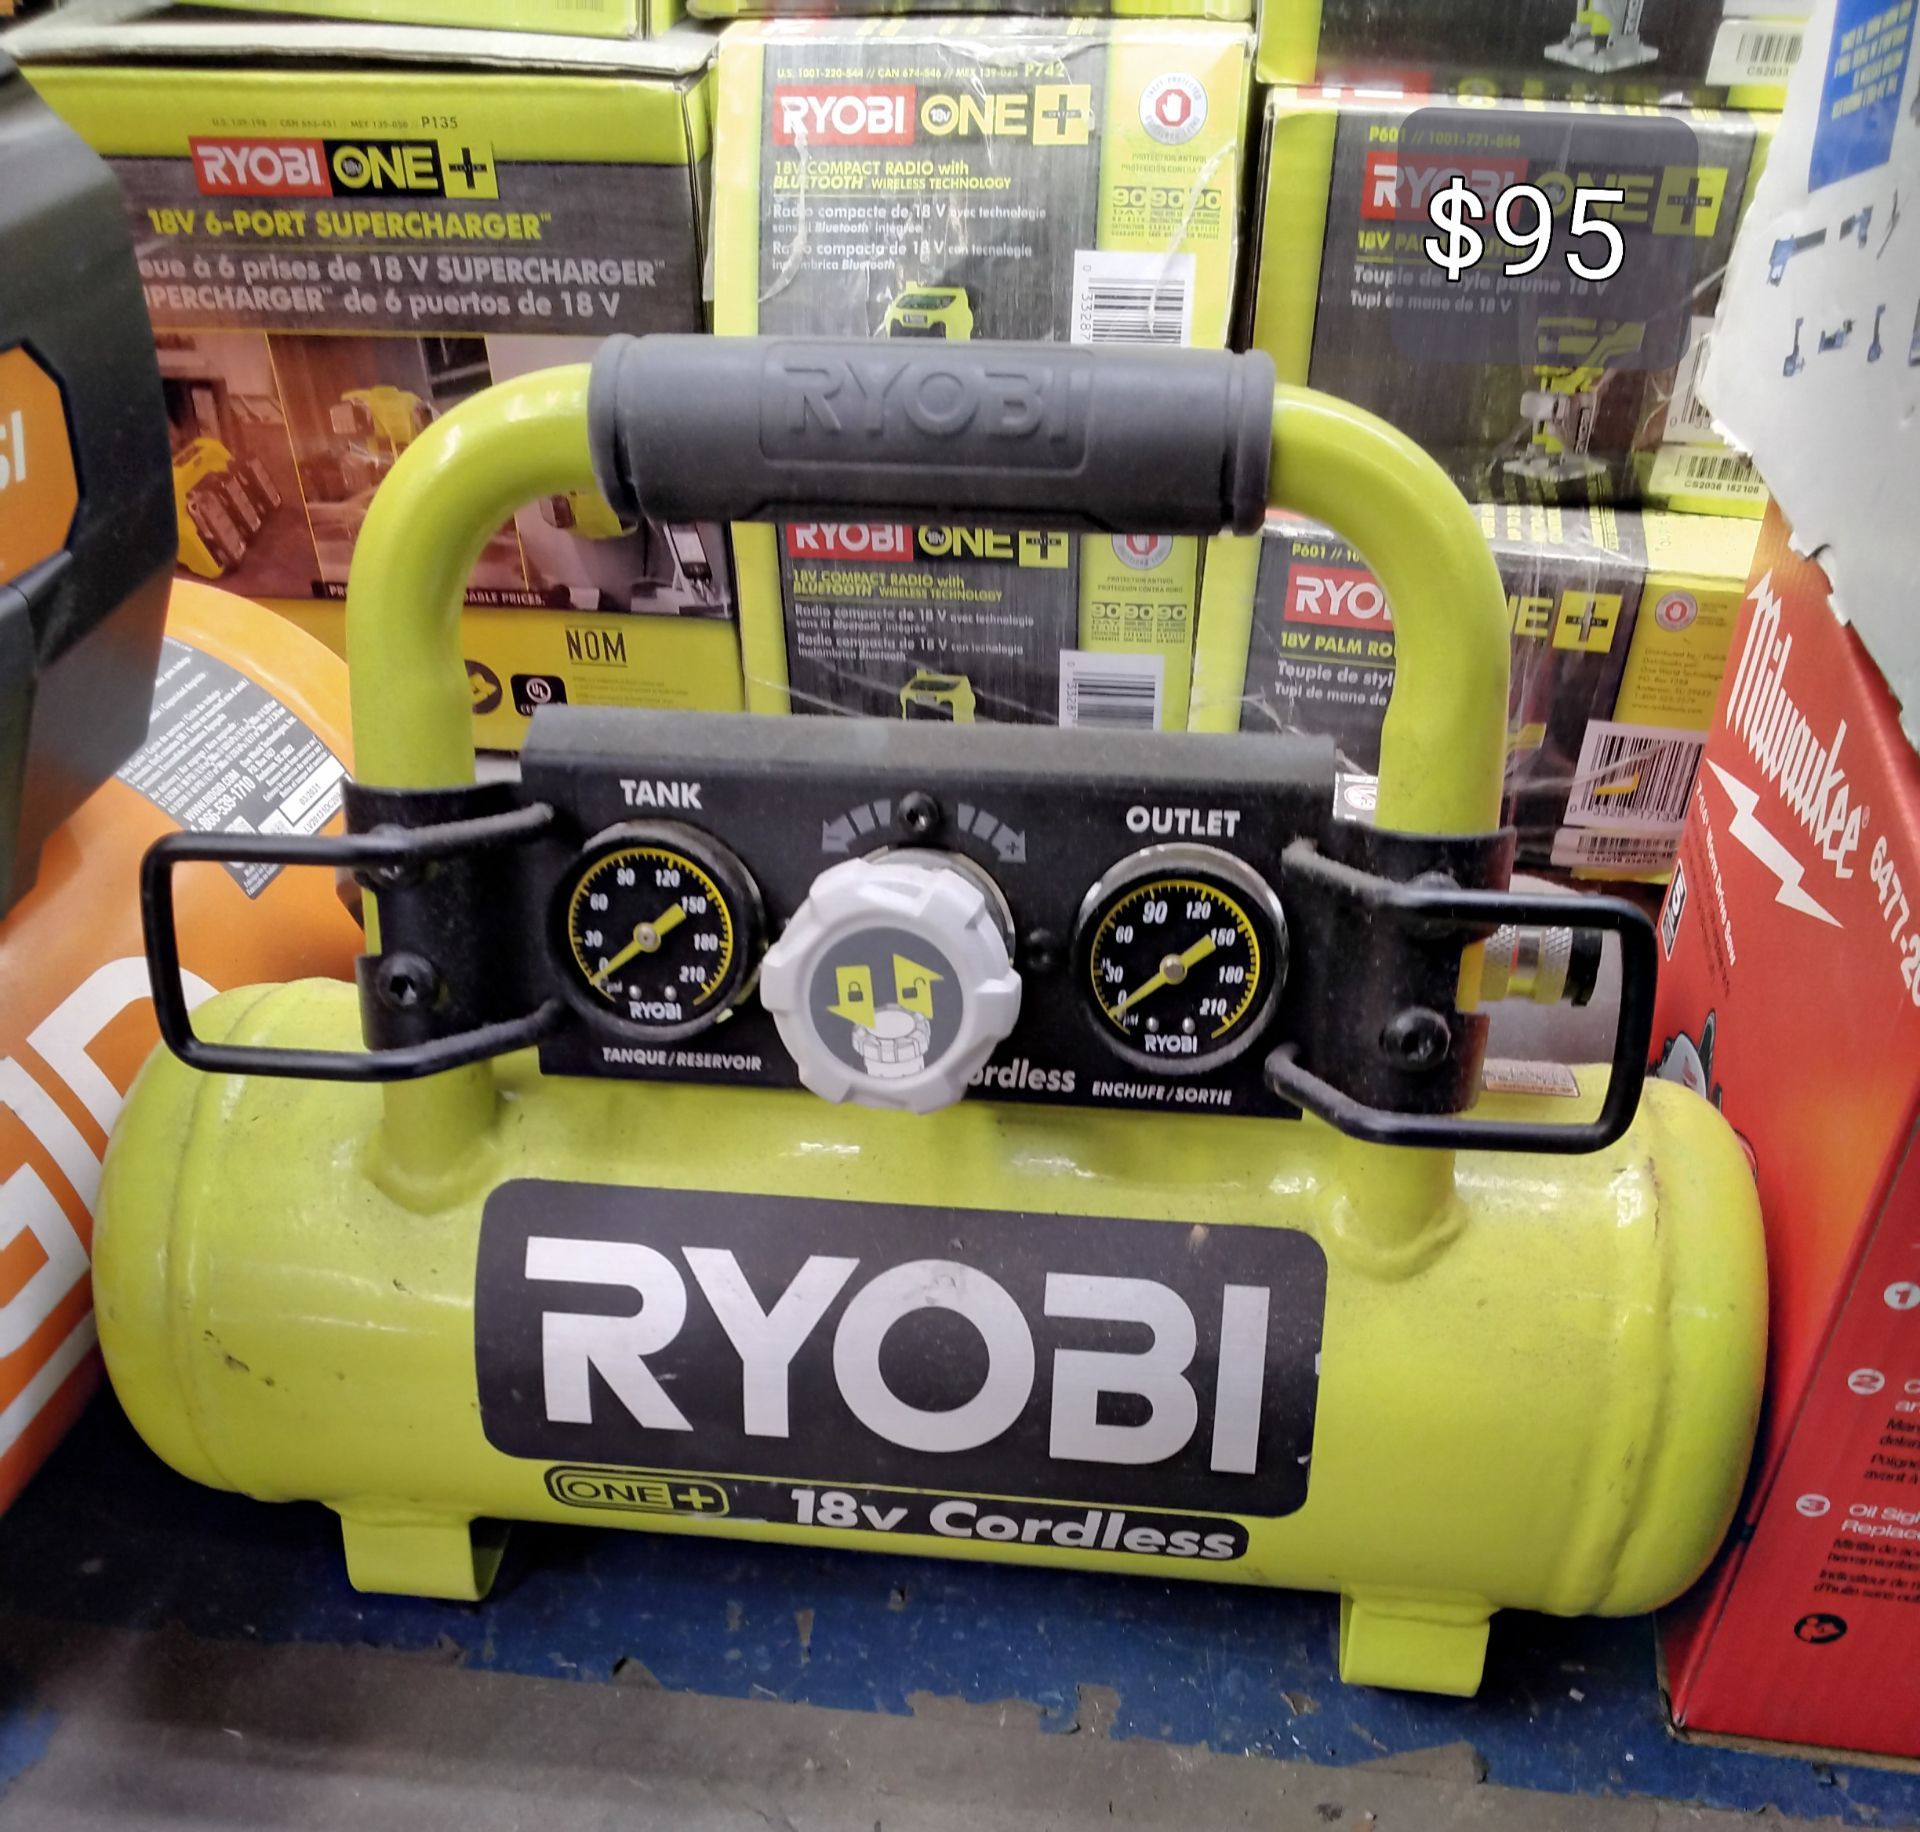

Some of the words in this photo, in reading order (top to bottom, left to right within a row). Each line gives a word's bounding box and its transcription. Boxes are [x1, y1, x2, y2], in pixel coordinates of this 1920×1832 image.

[421, 115, 458, 130] P135
[781, 95, 906, 135] RYOBI
[1369, 125, 1405, 143] P601
[196, 145, 323, 187] RYOBI
[807, 160, 881, 176] COMPACT
[885, 160, 934, 176] RADIO
[938, 160, 969, 177] with
[773, 175, 864, 190] BLUTOOTH
[871, 177, 926, 191] WIRELESS
[929, 176, 1012, 190] TECHNOLOGY
[147, 208, 195, 236] 18V
[204, 209, 306, 237] 6-PORT
[773, 204, 814, 219] Rado
[818, 205, 886, 221] compacte
[891, 203, 909, 218] de
[912, 204, 931, 218] 18
[979, 205, 1046, 221] technologie
[1358, 231, 1391, 251] 18V
[218, 253, 236, 279] 6
[242, 254, 321, 285] prises
[327, 254, 362, 281] de
[369, 255, 403, 282] 18
[407, 256, 429, 283] V
[343, 286, 378, 314] de
[384, 287, 402, 313] 6
[409, 291, 511, 320] puertos
[517, 290, 551, 316] de
[560, 291, 595, 317] 18
[599, 292, 620, 318] V
[782, 361, 1075, 444] RYOBI
[795, 524, 905, 553] RYOBI
[1292, 543, 1326, 560] P601
[821, 571, 886, 587] COMPACT
[890, 572, 934, 588] RADIO
[937, 574, 965, 589] with
[1295, 575, 1392, 621] RYO
[565, 629, 627, 664] NOM
[1281, 631, 1311, 648] 18V
[1314, 635, 1363, 655] PALM
[1277, 660, 1333, 683] Toupie
[1337, 667, 1359, 684] de
[1726, 568, 1863, 878] Milwaukee
[619, 779, 702, 810] TANK
[1126, 805, 1241, 838] OUTLET
[655, 868, 680, 888] 120
[682, 896, 706, 914] 150
[1142, 900, 1168, 925] 90
[1186, 901, 1212, 920] 120
[1115, 925, 1134, 944] 60
[679, 966, 706, 984] 210
[629, 1001, 682, 1020] RYOBI
[1200, 998, 1228, 1016] 210
[1144, 1034, 1198, 1053] RYOBI
[967, 1058, 1076, 1093] ordless
[1092, 1080, 1232, 1106] ENCHUFE/SORTIE
[525, 1236, 1270, 1474] RYOBI
[1849, 1503, 1877, 1519] Oil
[791, 1488, 908, 1533] 18v
[928, 1501, 1237, 1560] Cordless
